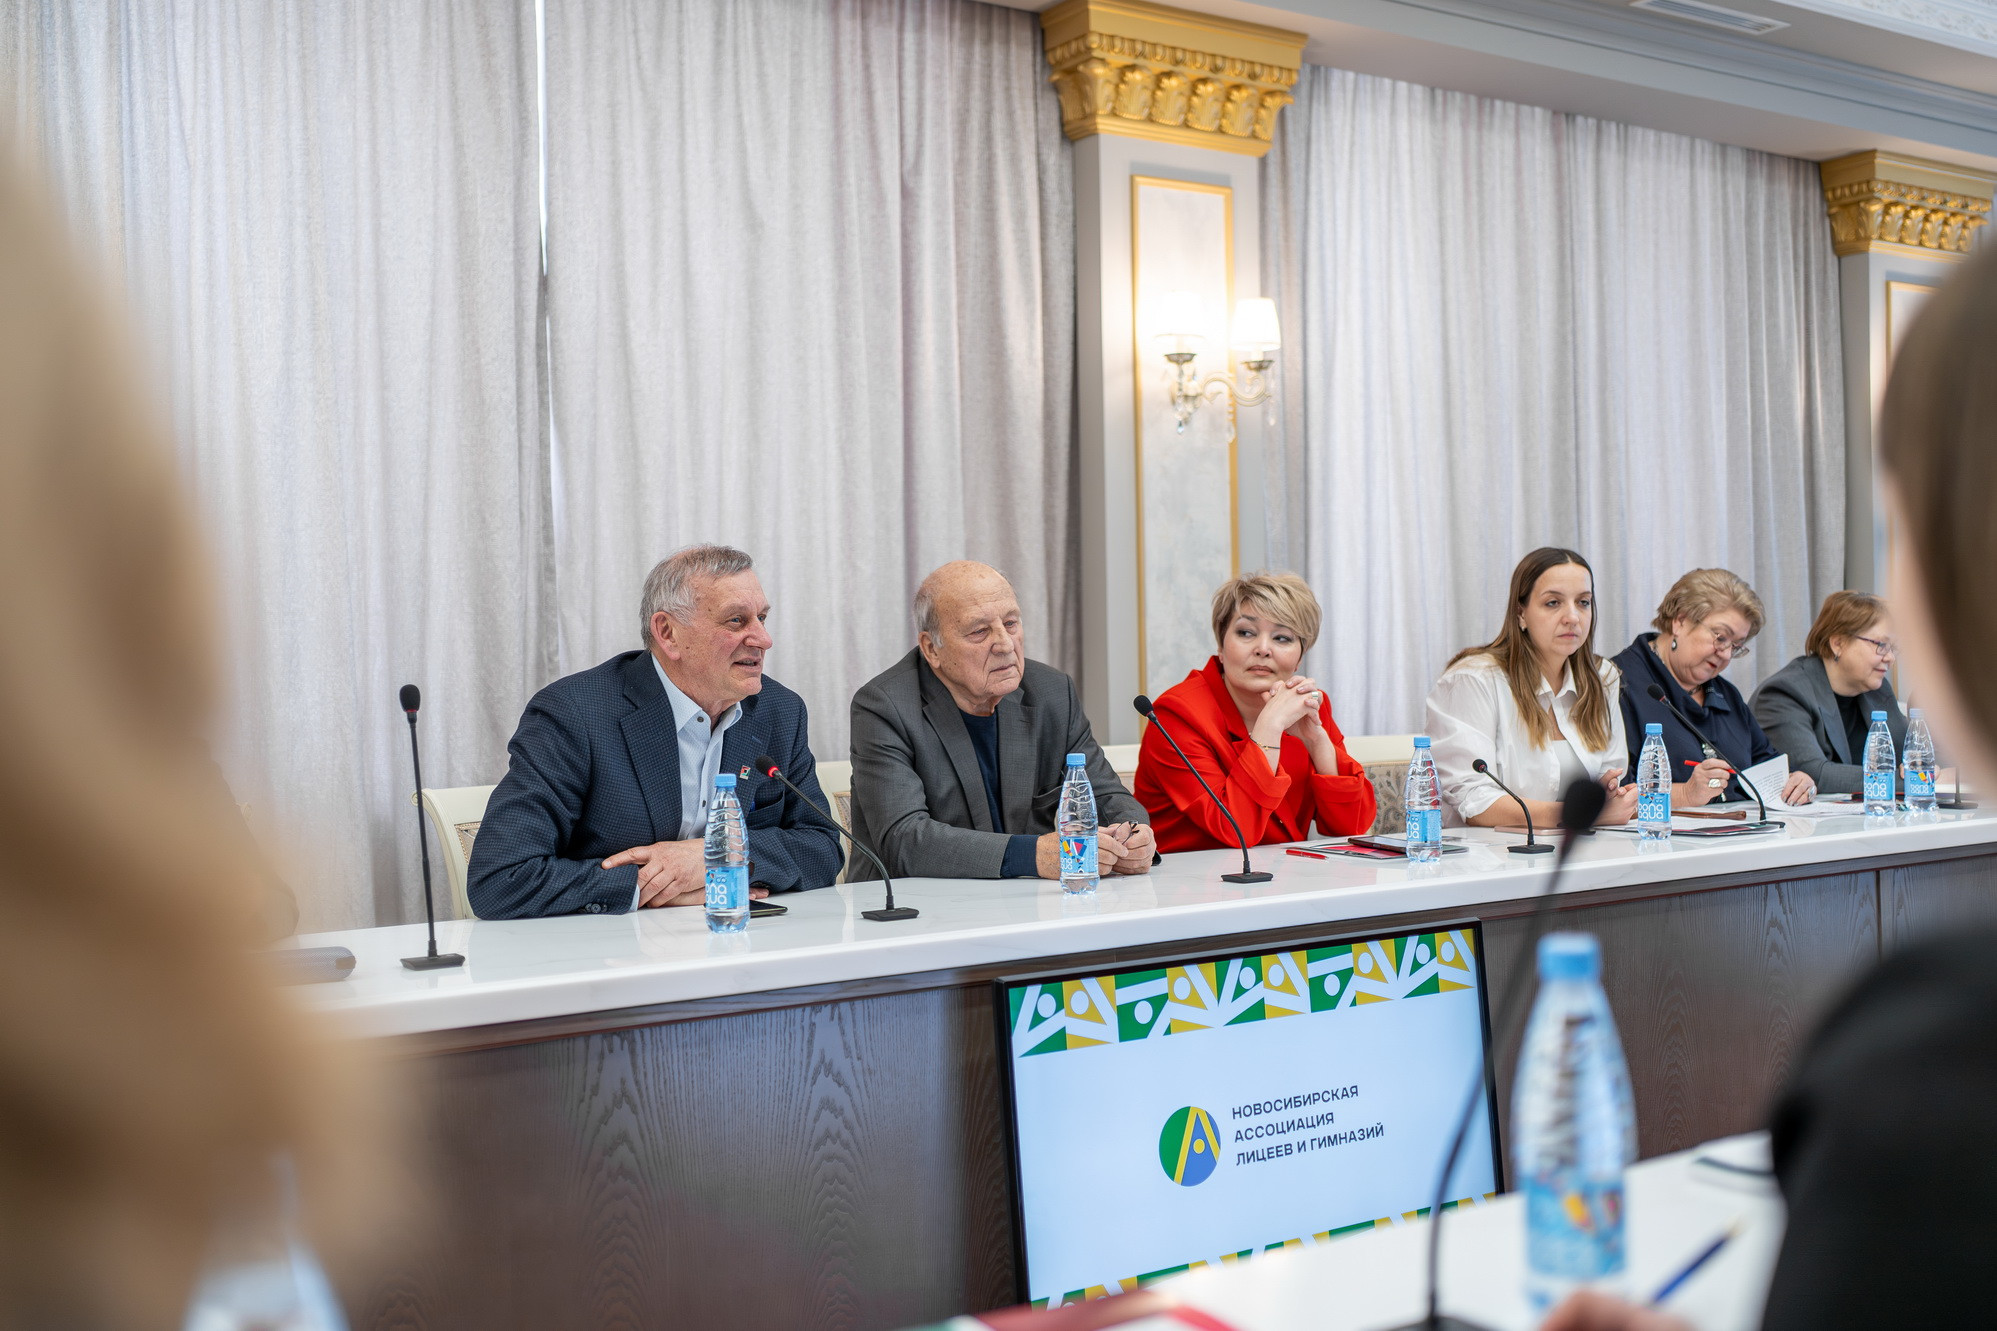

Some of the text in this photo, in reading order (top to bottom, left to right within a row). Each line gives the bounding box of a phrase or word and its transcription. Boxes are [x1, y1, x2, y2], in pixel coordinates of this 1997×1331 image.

[1232, 1084, 1359, 1120] НОВОСИБИРСКАЯ
[1234, 1111, 1335, 1143] АССОЦИАЦИЯ
[1236, 1121, 1384, 1167] ЛИЦЕЕВ И ГИМНАЗИЙ
